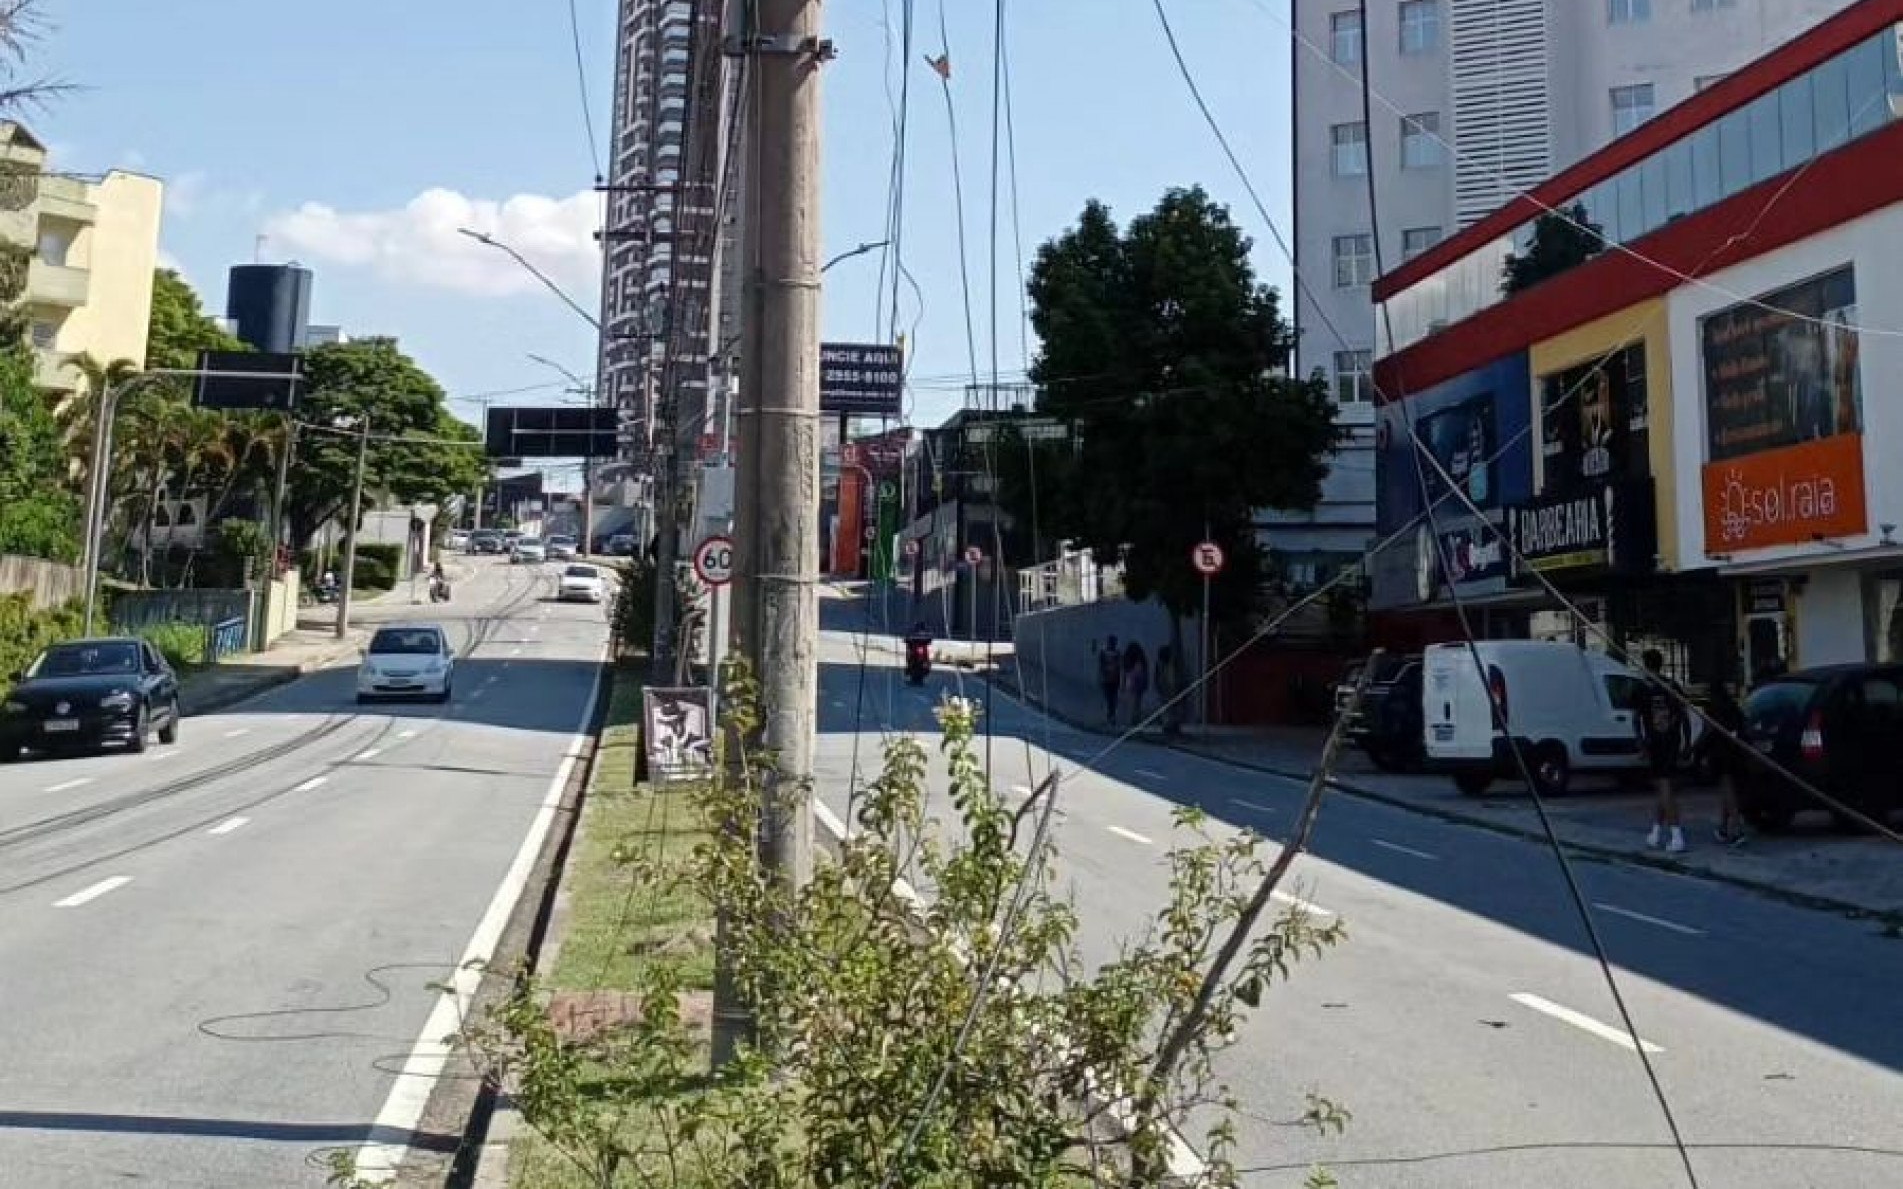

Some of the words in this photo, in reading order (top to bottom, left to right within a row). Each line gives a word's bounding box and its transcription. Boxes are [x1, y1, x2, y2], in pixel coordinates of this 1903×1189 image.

[864, 351, 898, 365] AQUI
[1521, 496, 1600, 554] BARBEARIA
[703, 548, 731, 569] 60
